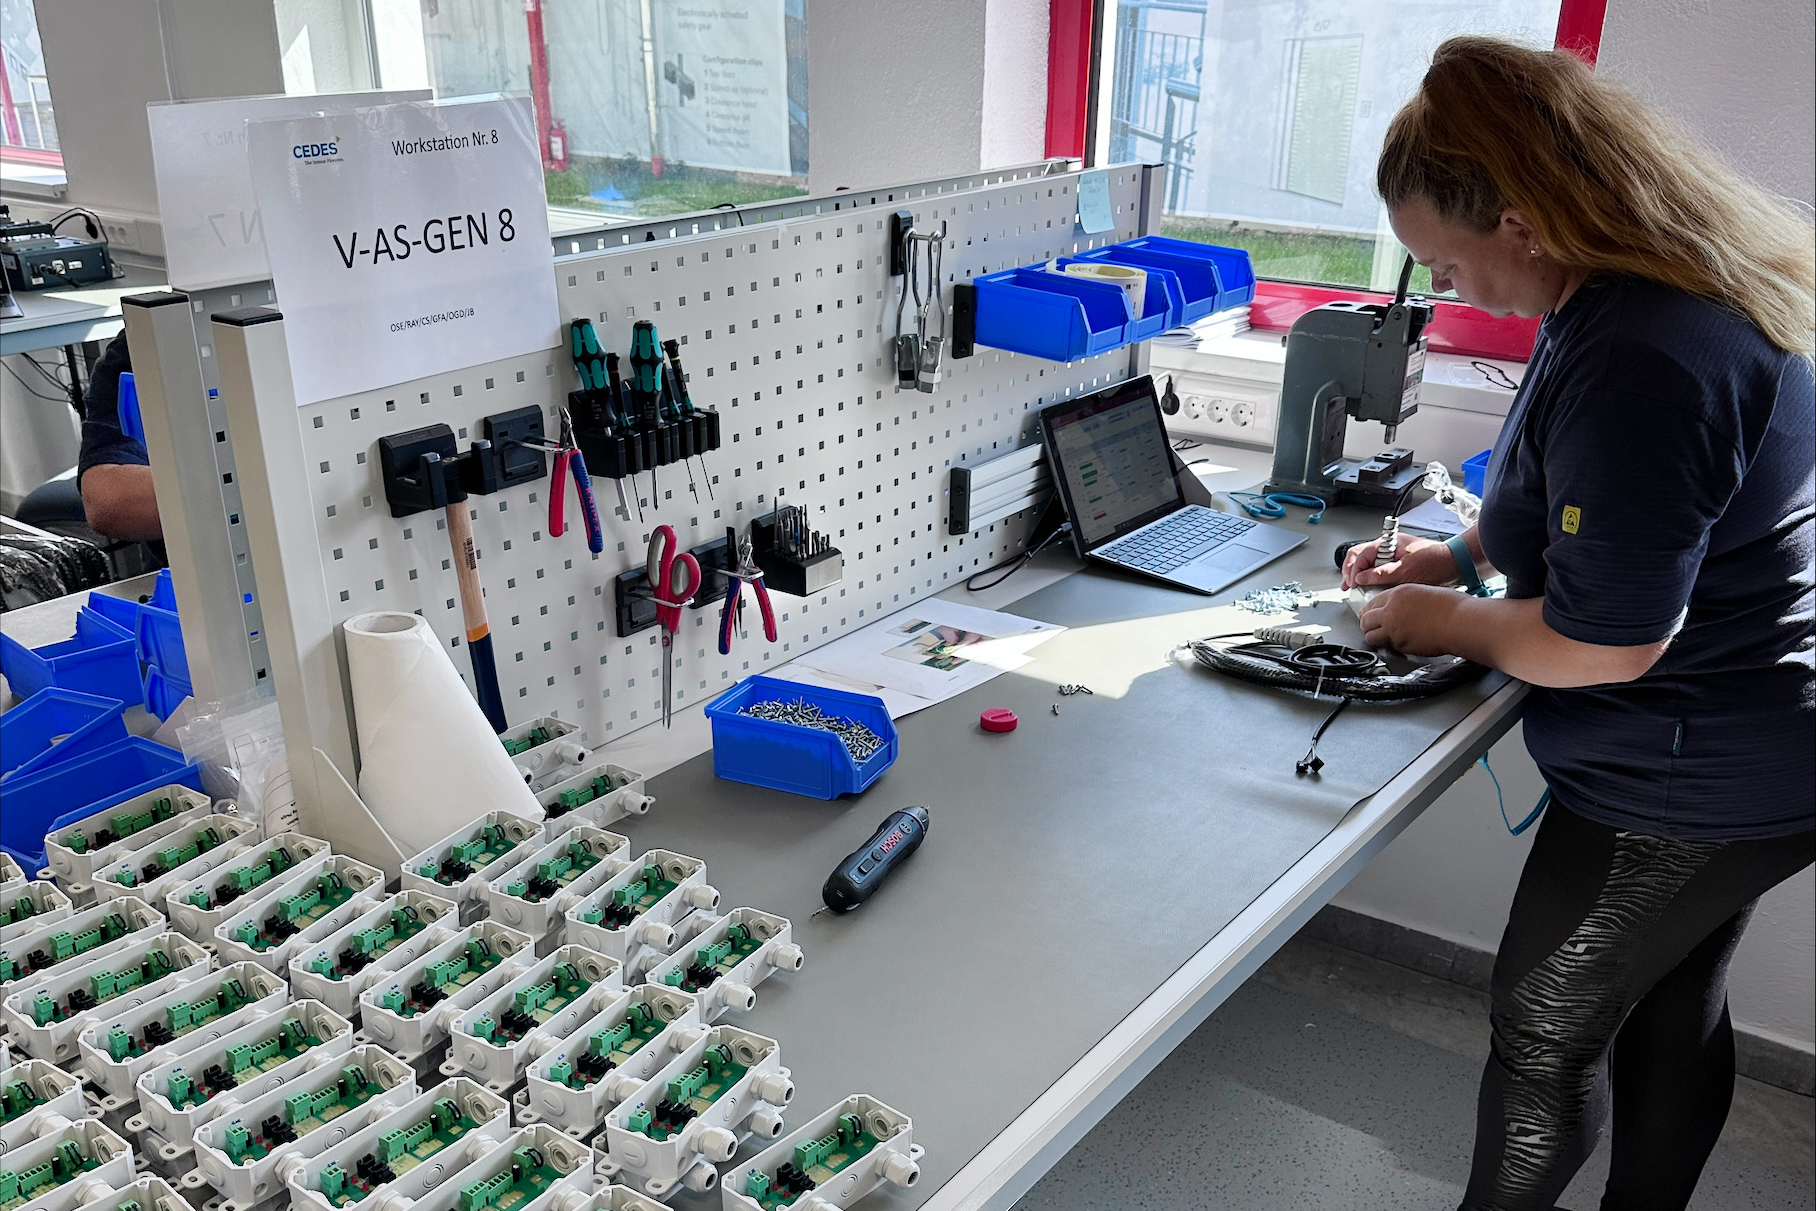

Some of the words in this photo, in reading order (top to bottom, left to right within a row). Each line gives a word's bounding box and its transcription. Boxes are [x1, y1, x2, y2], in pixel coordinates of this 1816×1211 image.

[293, 142, 338, 158] CEDES
[391, 134, 469, 156] Workstation
[472, 131, 488, 147] Nr.
[491, 129, 499, 144] 8
[332, 211, 489, 269] V-AS-GEN
[498, 208, 516, 242] 8
[879, 830, 904, 853] BOSCH
